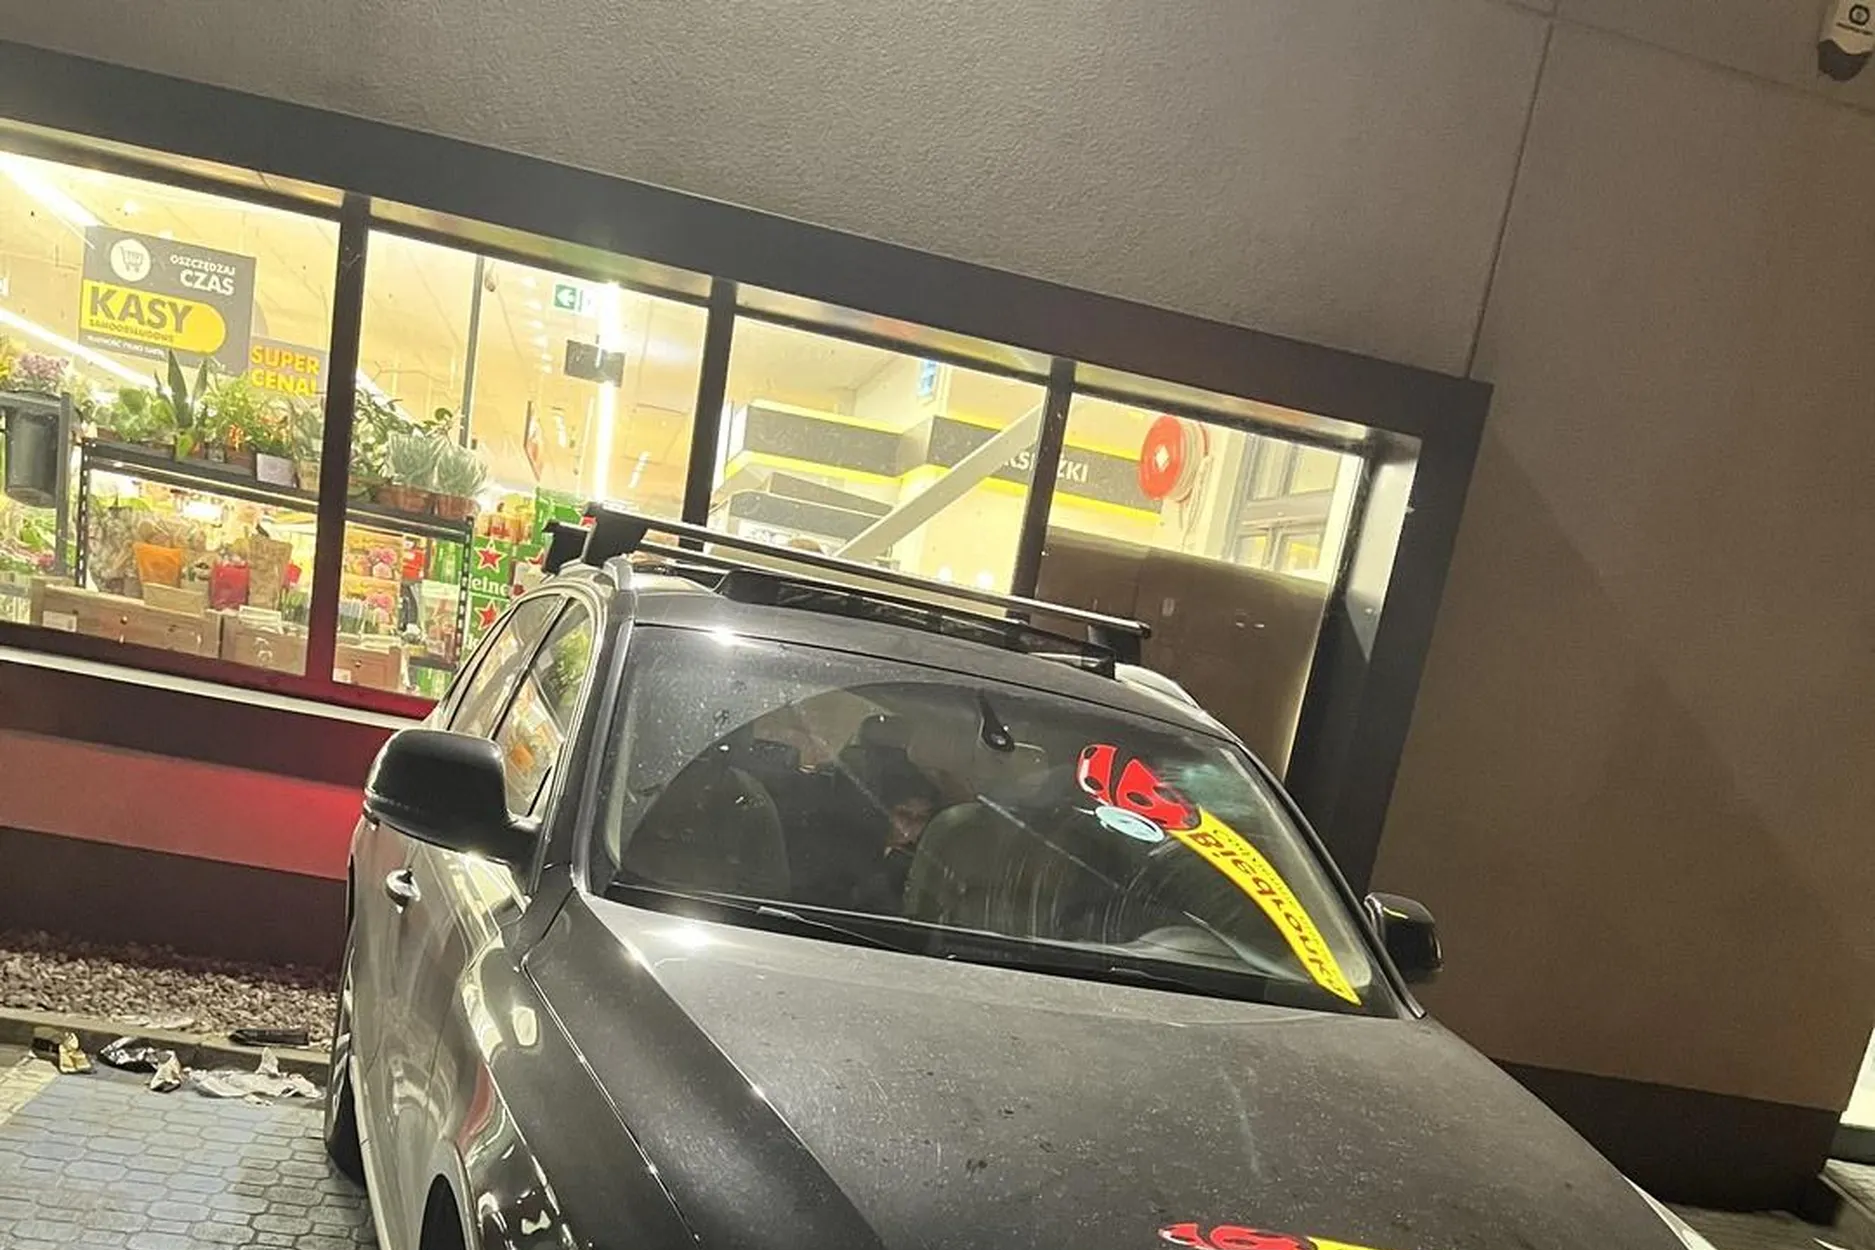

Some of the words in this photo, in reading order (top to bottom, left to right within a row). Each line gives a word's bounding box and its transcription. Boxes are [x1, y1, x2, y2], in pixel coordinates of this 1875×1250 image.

[170, 254, 236, 276] OSZCZĘDZAJ
[179, 269, 235, 297] CZAS
[91, 285, 194, 334] KASY
[251, 344, 320, 376] SUPER
[251, 369, 318, 398] CENA!
